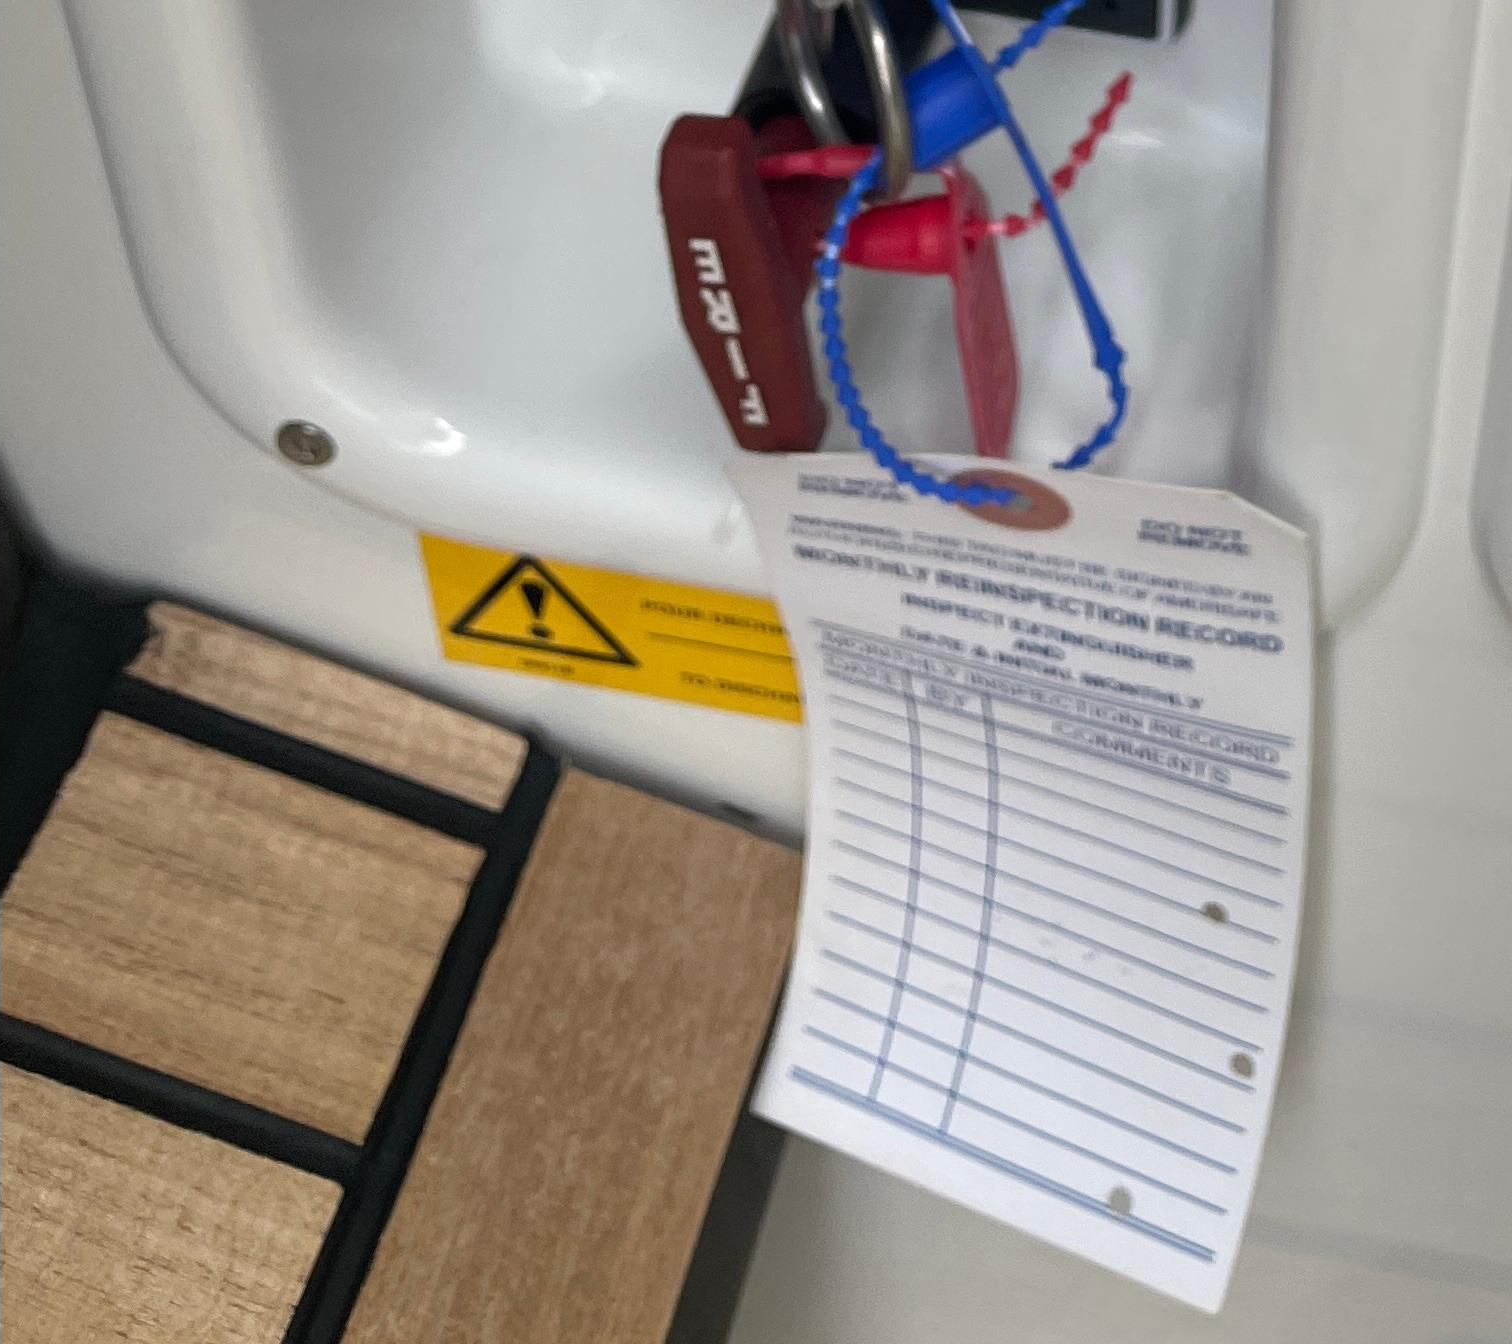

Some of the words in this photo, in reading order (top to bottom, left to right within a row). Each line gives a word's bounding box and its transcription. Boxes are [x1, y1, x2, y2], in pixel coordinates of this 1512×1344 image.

[688, 237, 771, 427] FIRE
[793, 543, 930, 583] MONTHLY
[935, 567, 1151, 634] REINSPECTION
[1154, 615, 1286, 655] RECORD
[964, 669, 1145, 730] INSPECTION
[1148, 718, 1282, 765] RECORD
